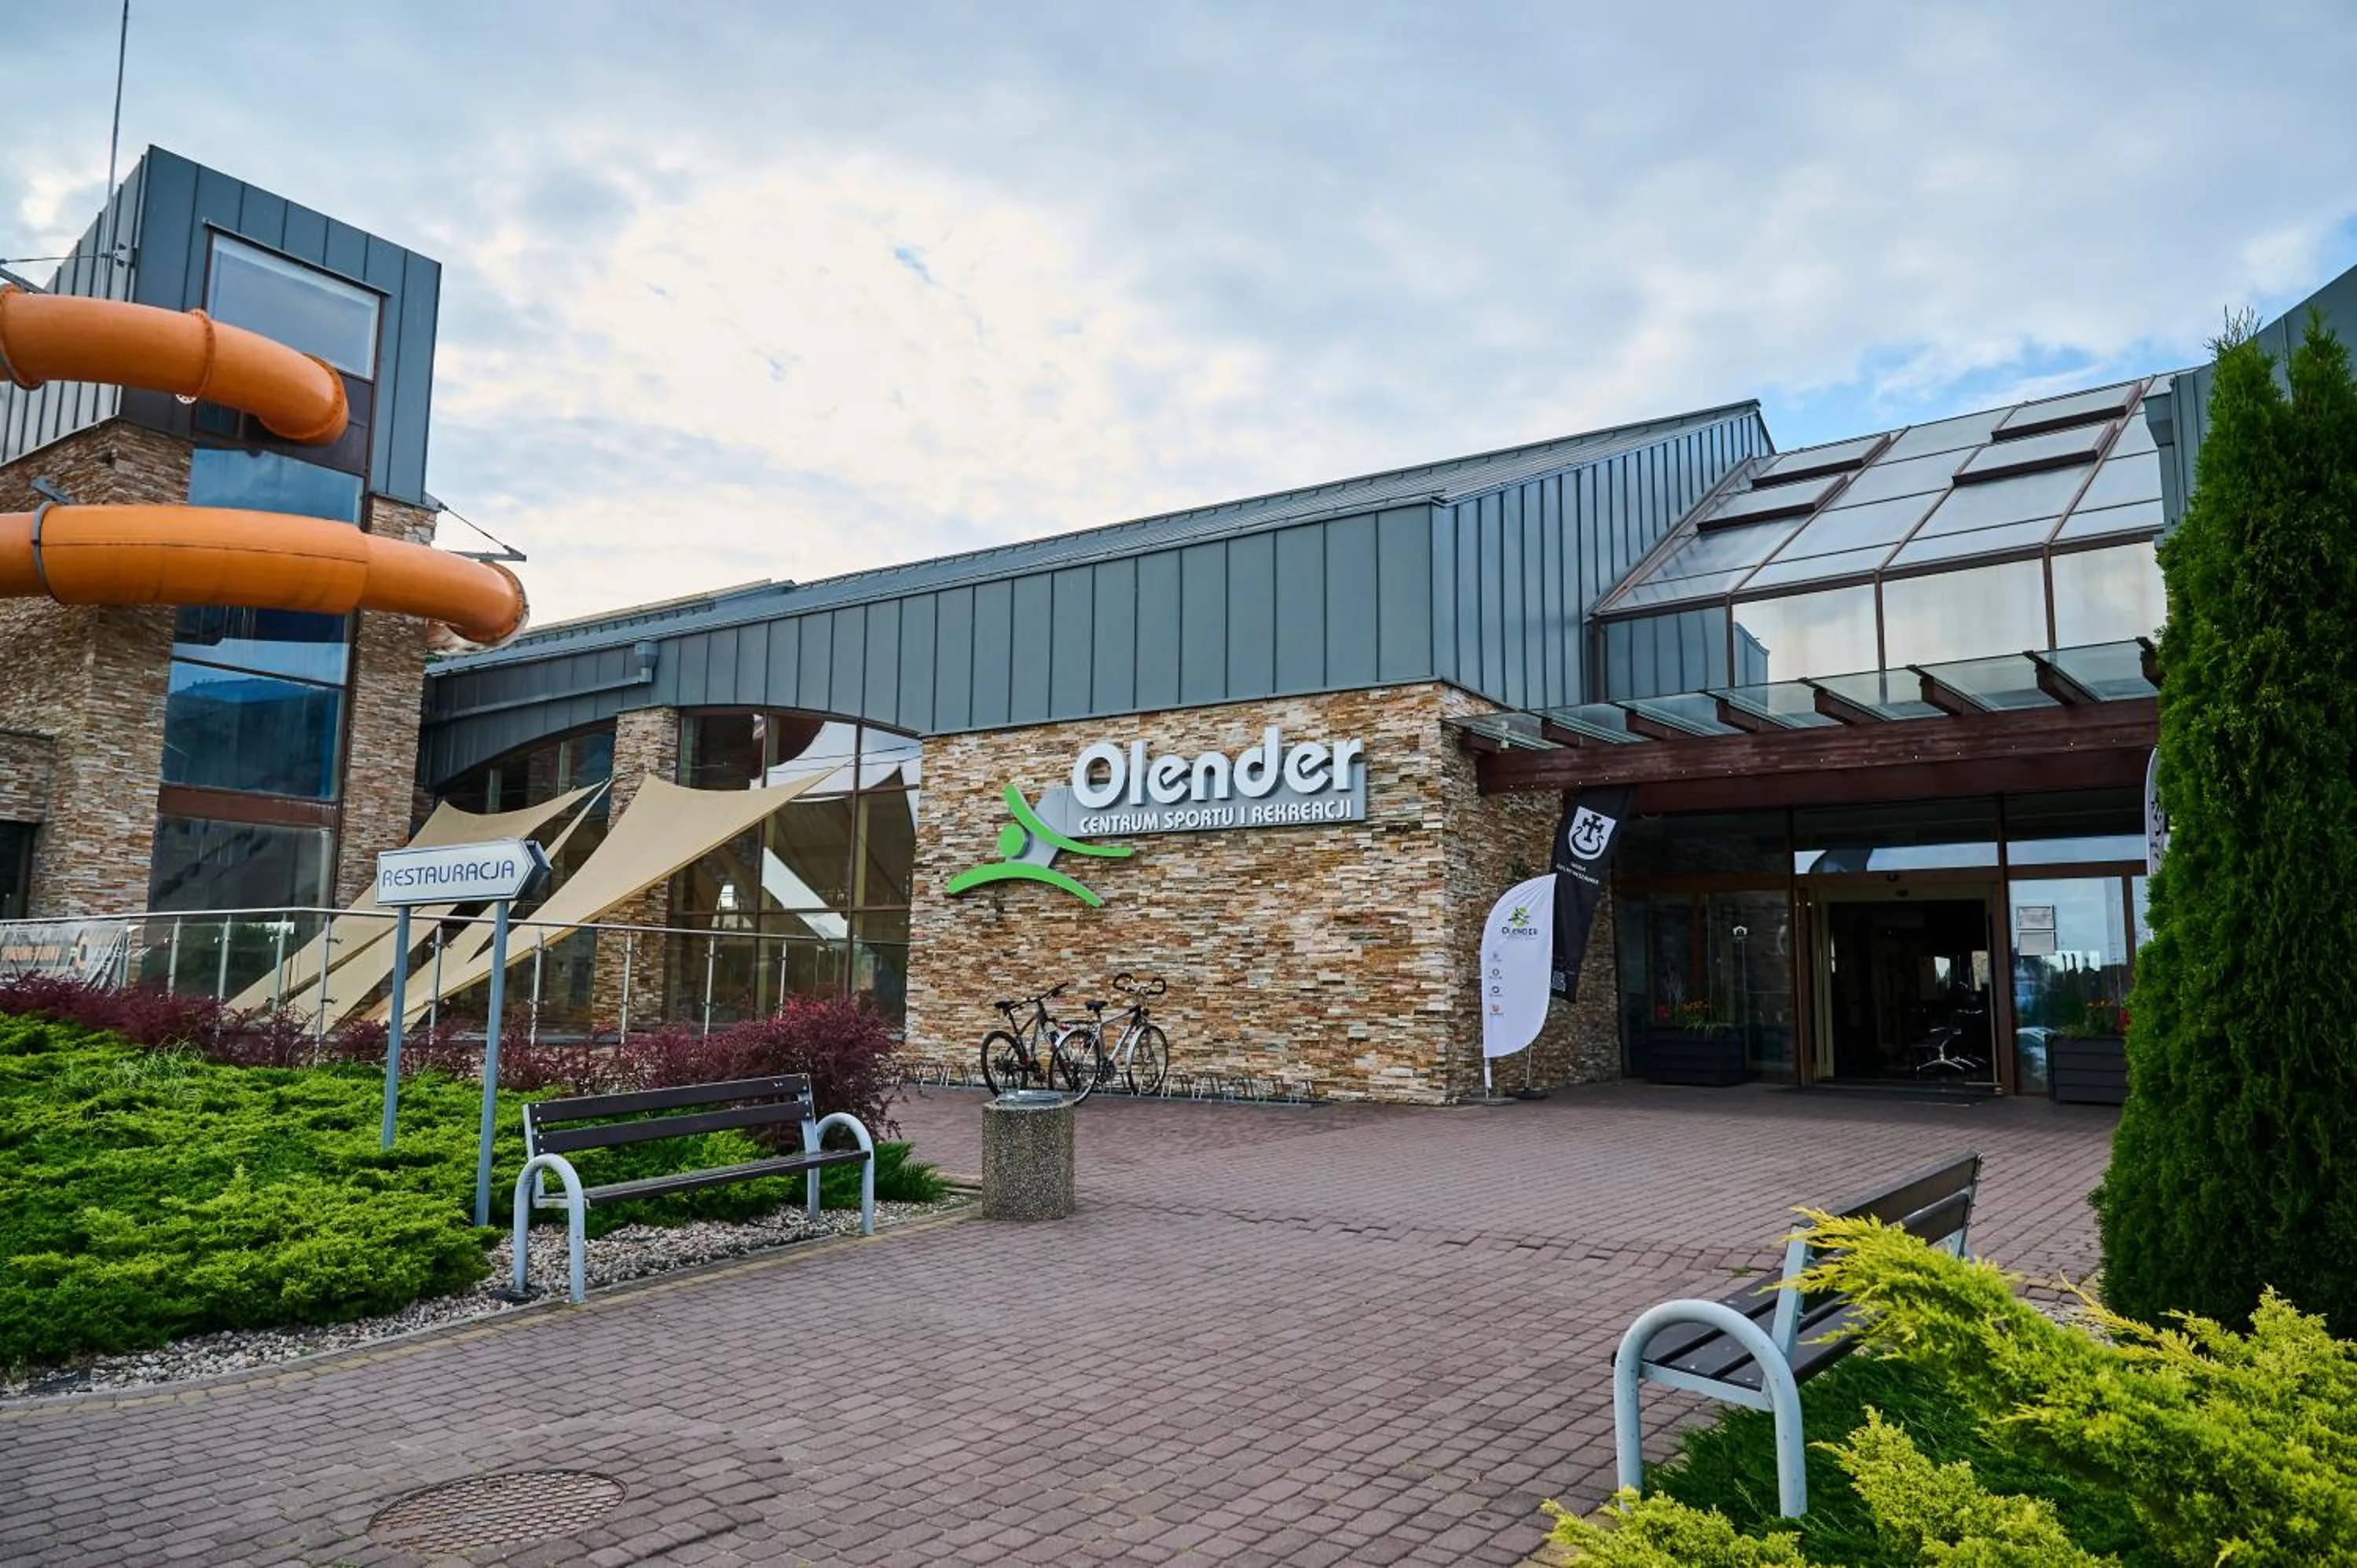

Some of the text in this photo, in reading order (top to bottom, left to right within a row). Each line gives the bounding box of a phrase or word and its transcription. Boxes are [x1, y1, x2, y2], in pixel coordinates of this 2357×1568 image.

[1072, 726, 1364, 808] Olender
[1079, 799, 1352, 833] CENTRUM SPORTU I REKREACJI
[382, 860, 515, 888] RESTAURACJA
